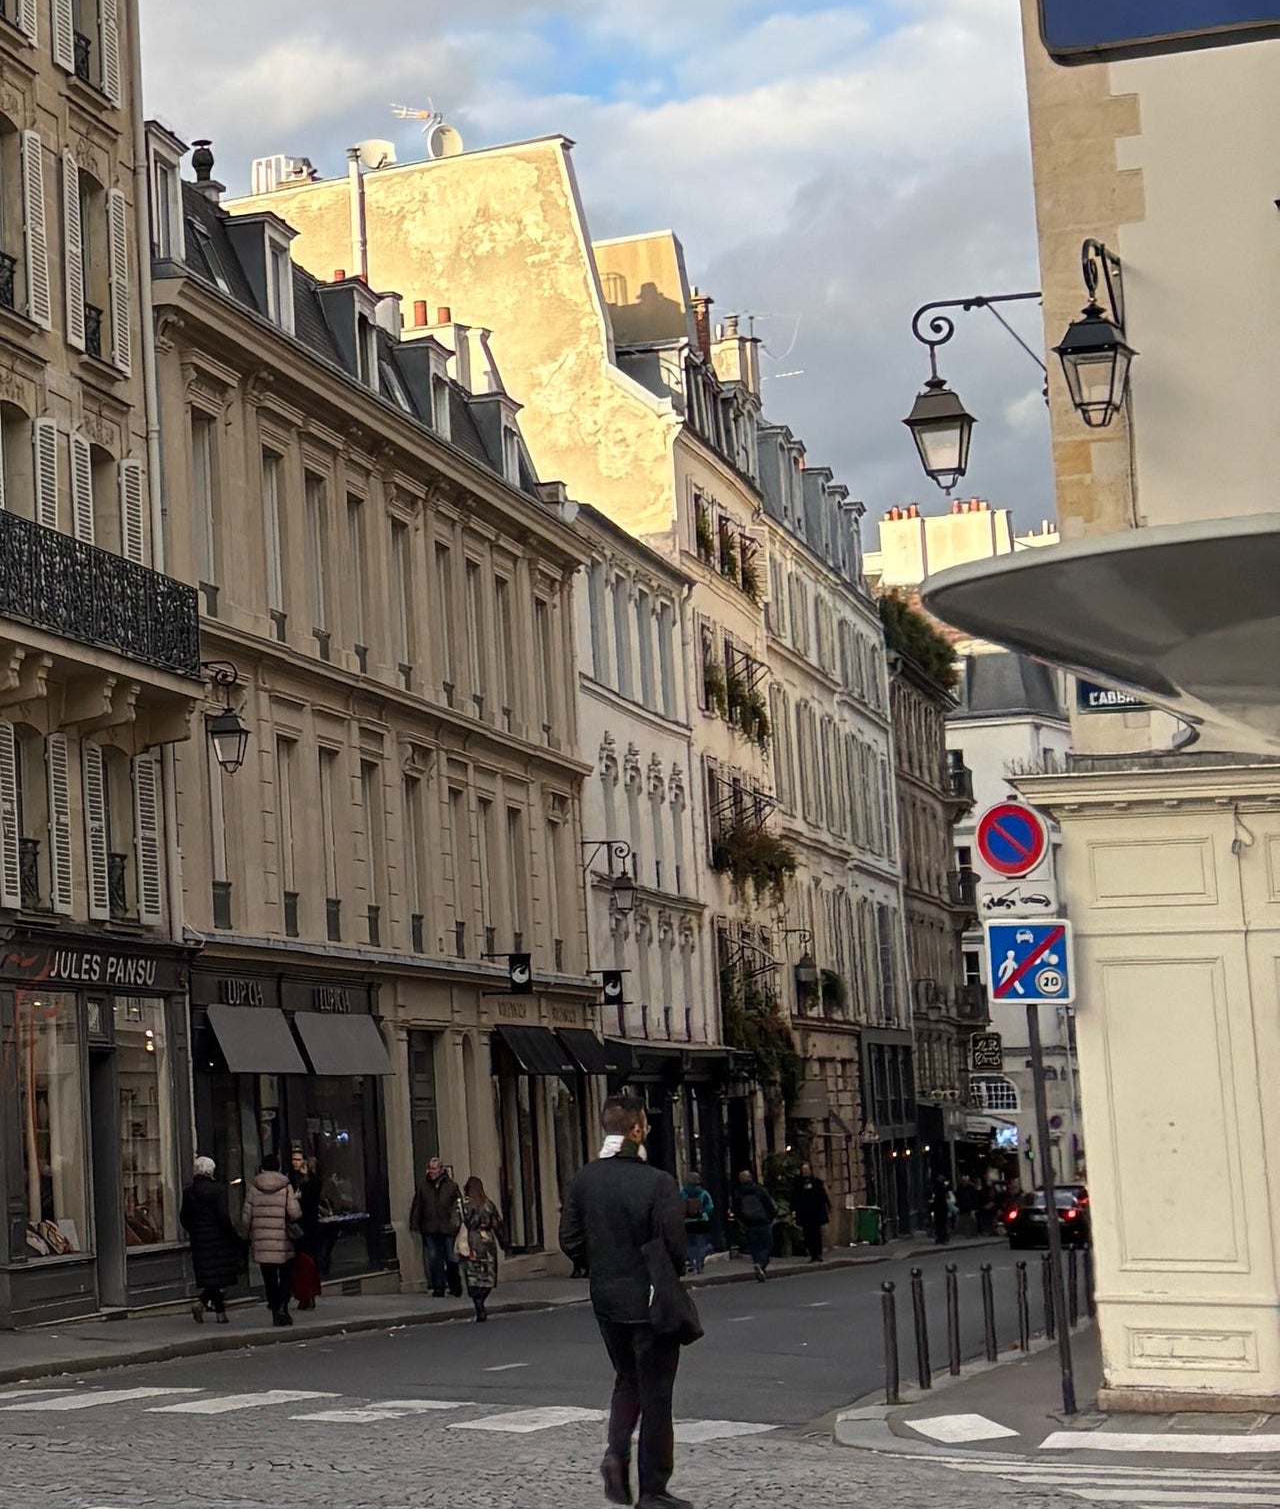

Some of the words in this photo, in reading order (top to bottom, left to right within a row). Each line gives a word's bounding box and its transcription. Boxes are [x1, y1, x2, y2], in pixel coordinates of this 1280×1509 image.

[50, 951, 101, 981] JULES
[106, 956, 157, 986] PANSU
[1043, 977, 1059, 987] 20
